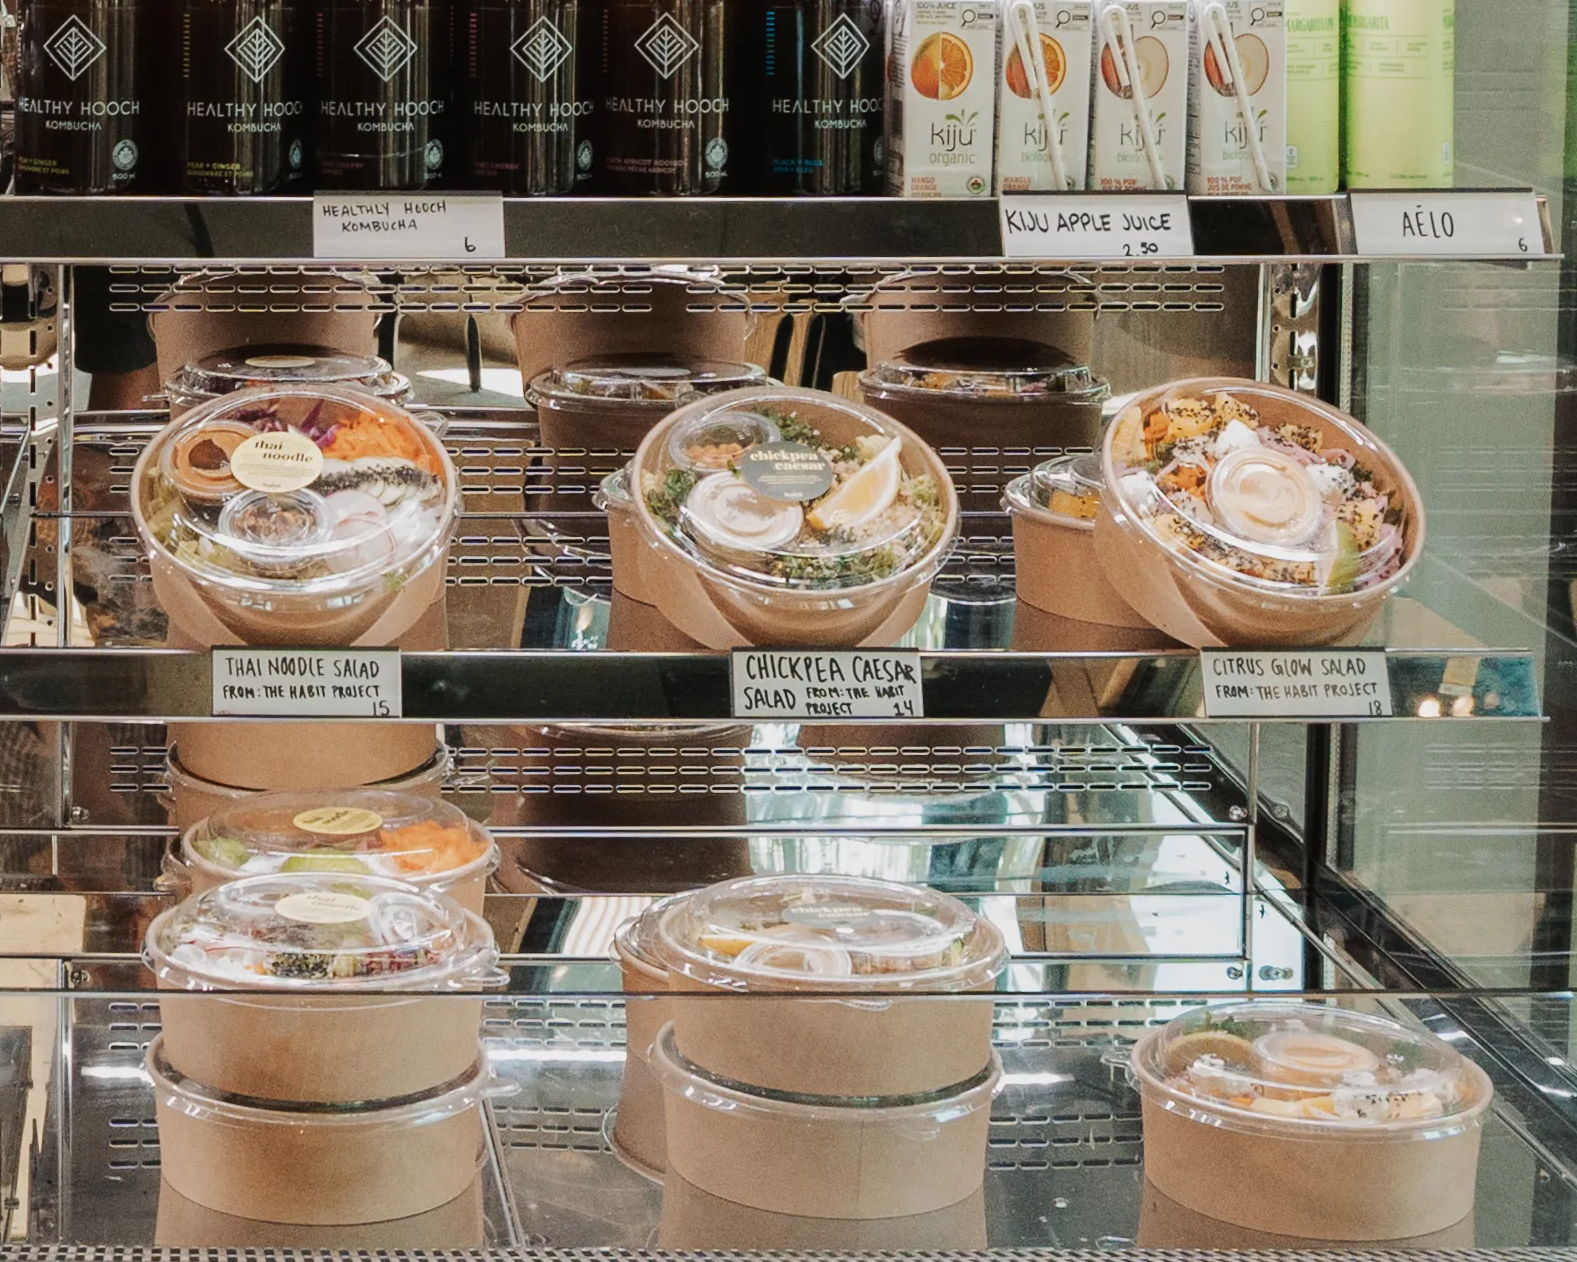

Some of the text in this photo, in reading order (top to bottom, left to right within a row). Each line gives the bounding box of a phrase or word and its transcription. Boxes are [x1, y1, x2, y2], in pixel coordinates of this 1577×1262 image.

[474, 99, 594, 117] HEALTHY HOOCH
[513, 121, 569, 133] KOMBUCHA
[931, 121, 974, 152] kiju
[929, 151, 976, 166] organic
[404, 199, 447, 214] HOOCH
[341, 218, 418, 233] KOMBUCHA
[1005, 208, 1171, 235] KIJU APPLE JUICE
[464, 236, 477, 252] 6
[1123, 241, 1158, 256] 2.50
[1518, 237, 1528, 252] 6
[253, 439, 284, 450] thai
[262, 452, 314, 463] noodle
[225, 656, 380, 679] THAI NOODLE SALAD
[746, 654, 916, 684] CHICKPEA CAESAR
[1213, 657, 1366, 677] CITRUS GLOW SALAD
[262, 685, 285, 699] THE
[290, 685, 326, 699] HABIT
[333, 684, 380, 699] PROJECT
[744, 687, 796, 710] SALAD
[845, 687, 870, 699] THE
[875, 685, 906, 699] HABIT
[1256, 686, 1281, 700] THE
[1284, 684, 1319, 699] HABIT
[1324, 682, 1378, 698] PROJECT
[372, 700, 390, 717] 15
[805, 700, 914, 716] PROJECT 14
